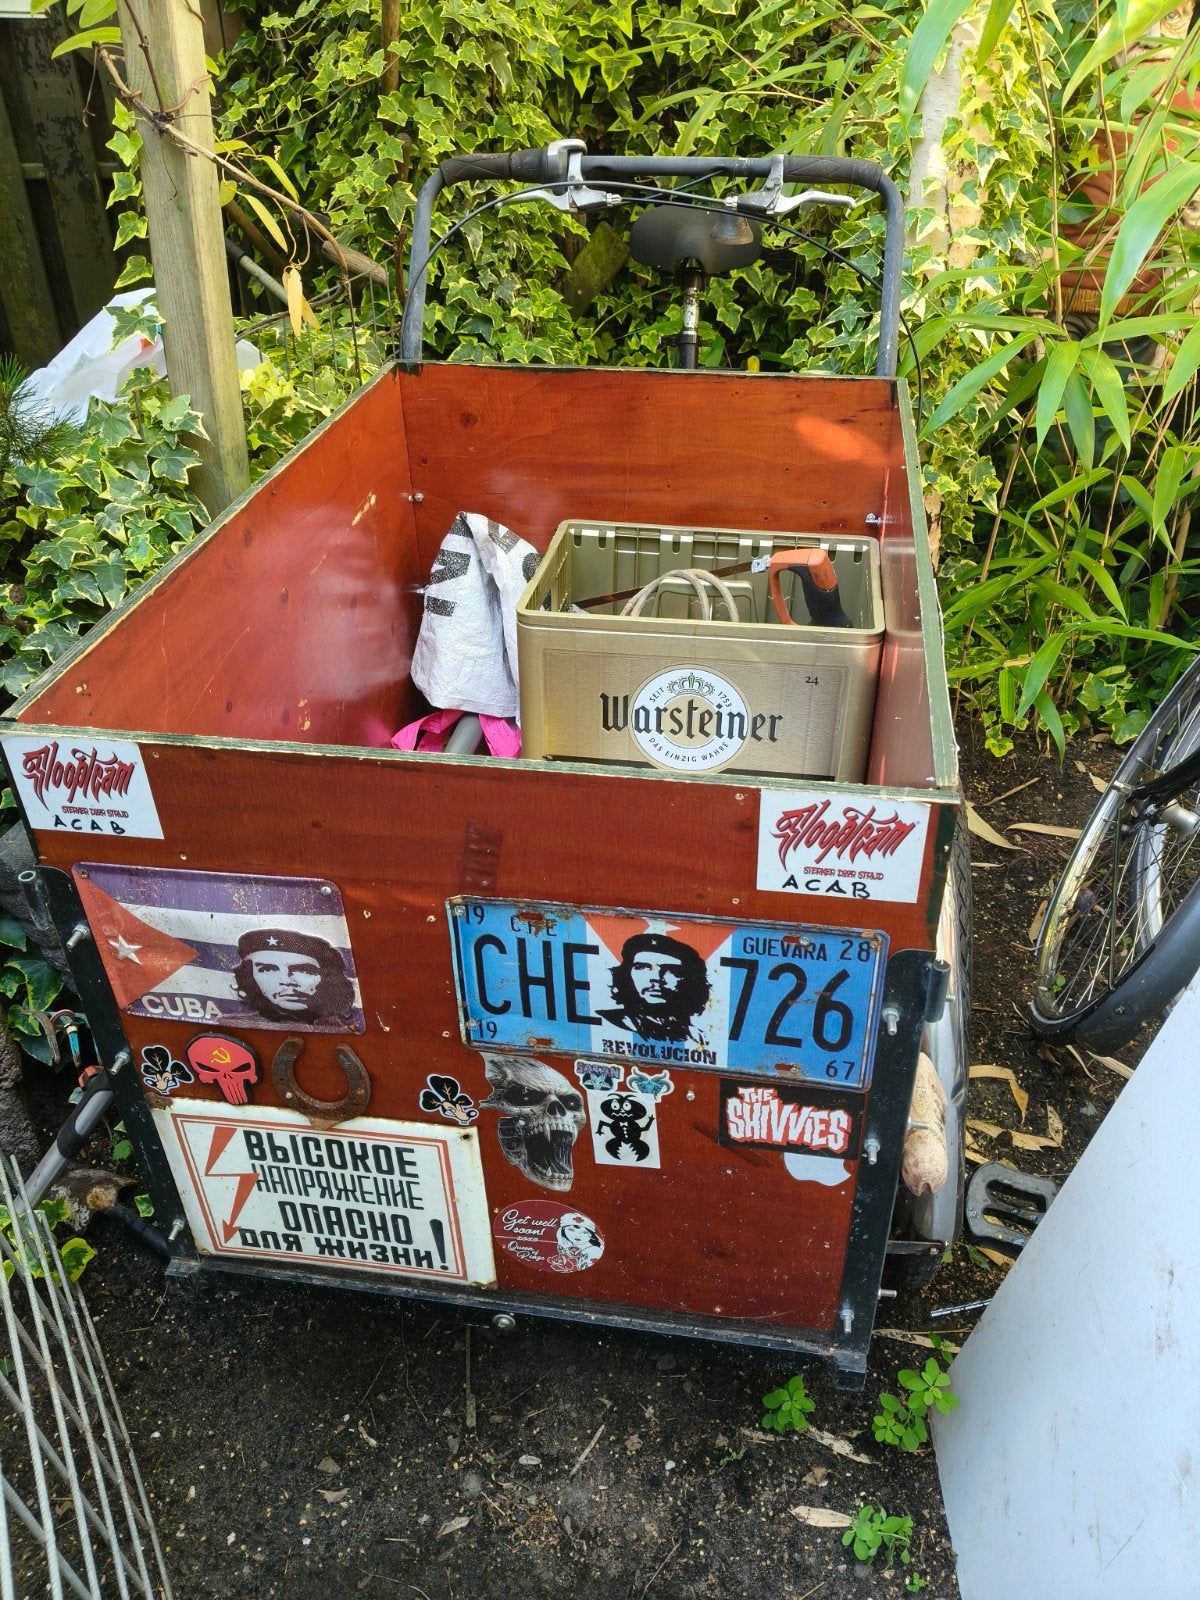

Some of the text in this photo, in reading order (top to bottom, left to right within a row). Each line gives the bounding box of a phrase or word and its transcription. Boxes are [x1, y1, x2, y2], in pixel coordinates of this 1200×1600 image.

[805, 676, 819, 686] 24
[649, 687, 733, 708] SEIT 1753
[600, 692, 783, 743] Warsteiner
[649, 737, 664, 752] DAS
[664, 750, 697, 762] EINZIG
[464, 905, 485, 925] 19
[742, 936, 828, 962] GUEVARA
[839, 939, 872, 963] 28
[473, 933, 854, 1053] CHE 726
[141, 995, 223, 1019] CUBA
[477, 1020, 856, 1081] 19 67
[602, 1038, 717, 1065] REVOLUCION
[738, 1086, 777, 1103] THE
[727, 1097, 851, 1154] SHIVVIES
[243, 1130, 419, 1178] ВЫСОКОЕ
[251, 1163, 425, 1210] НАПРЯЖЕНИЕ
[278, 1200, 414, 1245] ОПАСНО
[502, 1209, 559, 1230] Get well
[238, 1228, 303, 1252] ДЛЯ
[507, 1241, 535, 1252] Queen
